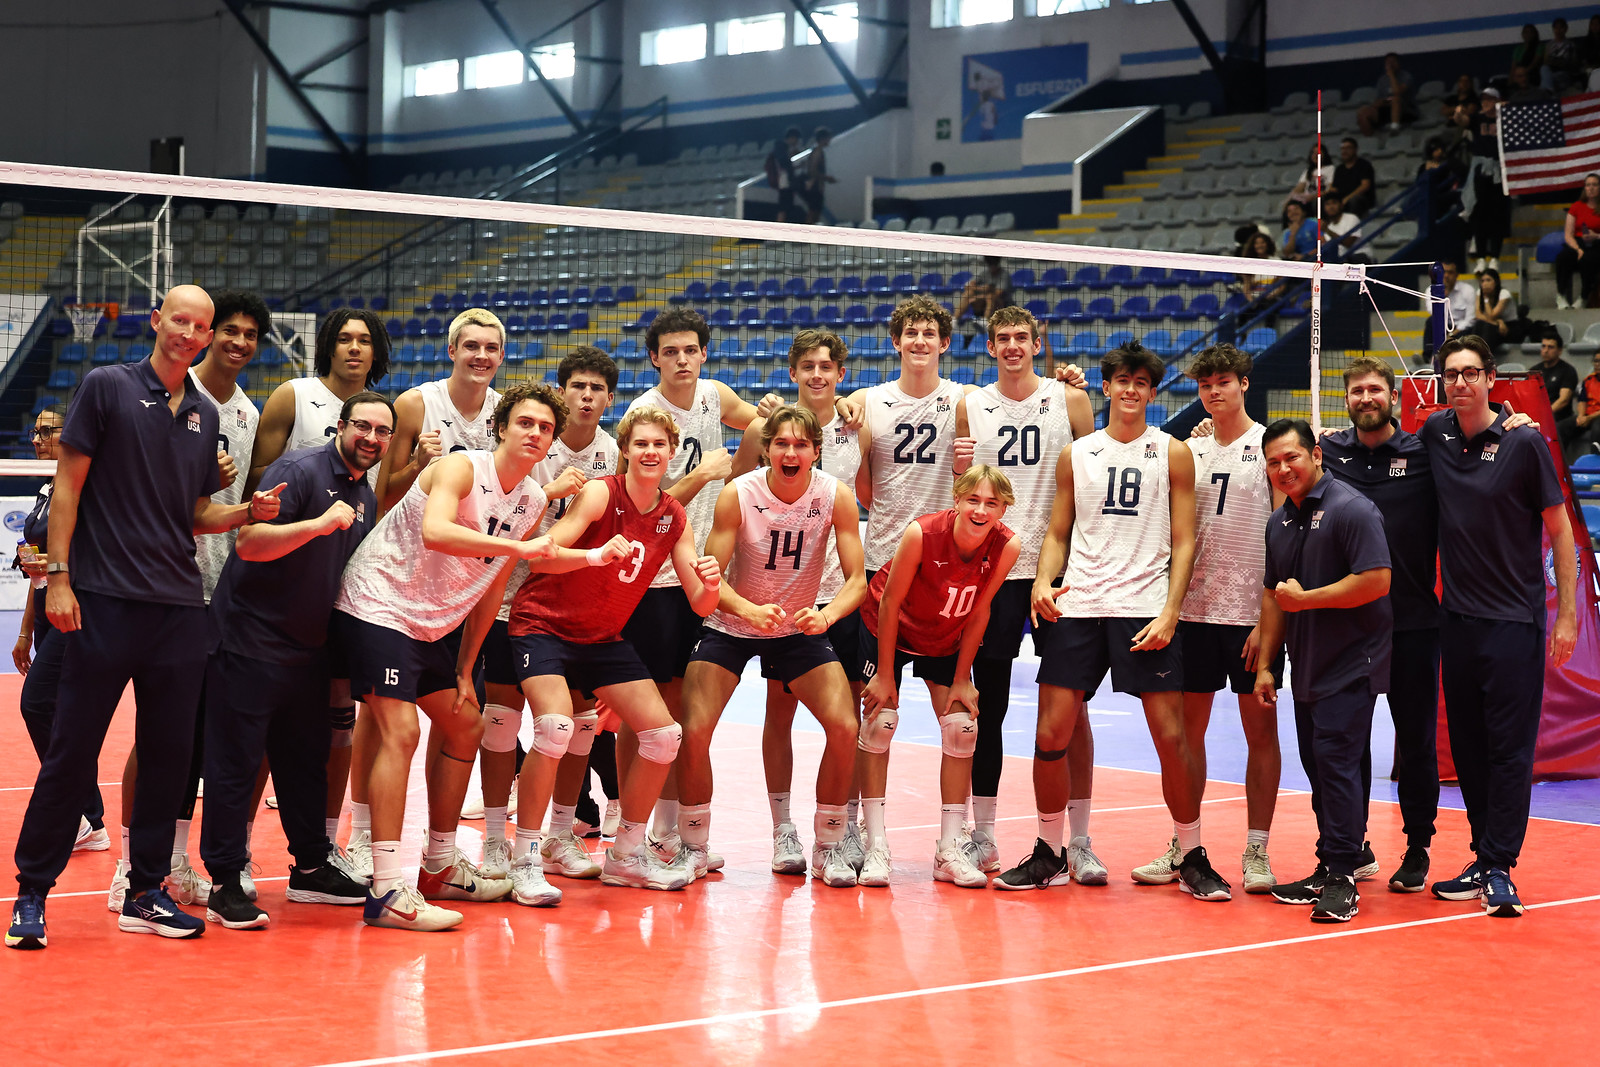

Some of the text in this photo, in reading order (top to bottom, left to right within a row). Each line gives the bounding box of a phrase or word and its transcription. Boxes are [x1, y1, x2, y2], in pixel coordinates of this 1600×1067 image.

[1312, 308, 1320, 355] Senoh
[936, 404, 951, 413] USA
[187, 420, 201, 433] USA
[236, 419, 248, 430] USA
[486, 429, 495, 438] US
[835, 436, 849, 445] USA
[894, 423, 937, 464] 22
[998, 425, 1041, 467] 20
[1143, 451, 1158, 459] USA
[1241, 454, 1258, 462] USA
[1480, 451, 1495, 462] USA
[592, 461, 607, 470] USA
[1388, 468, 1406, 477] USA
[1104, 466, 1142, 509] 18
[1210, 472, 1231, 516] 7
[764, 530, 804, 571] 14
[618, 539, 646, 584] 3
[938, 585, 978, 619] 10
[523, 653, 530, 668] 3
[862, 659, 876, 678] 10
[384, 667, 400, 686] 15
